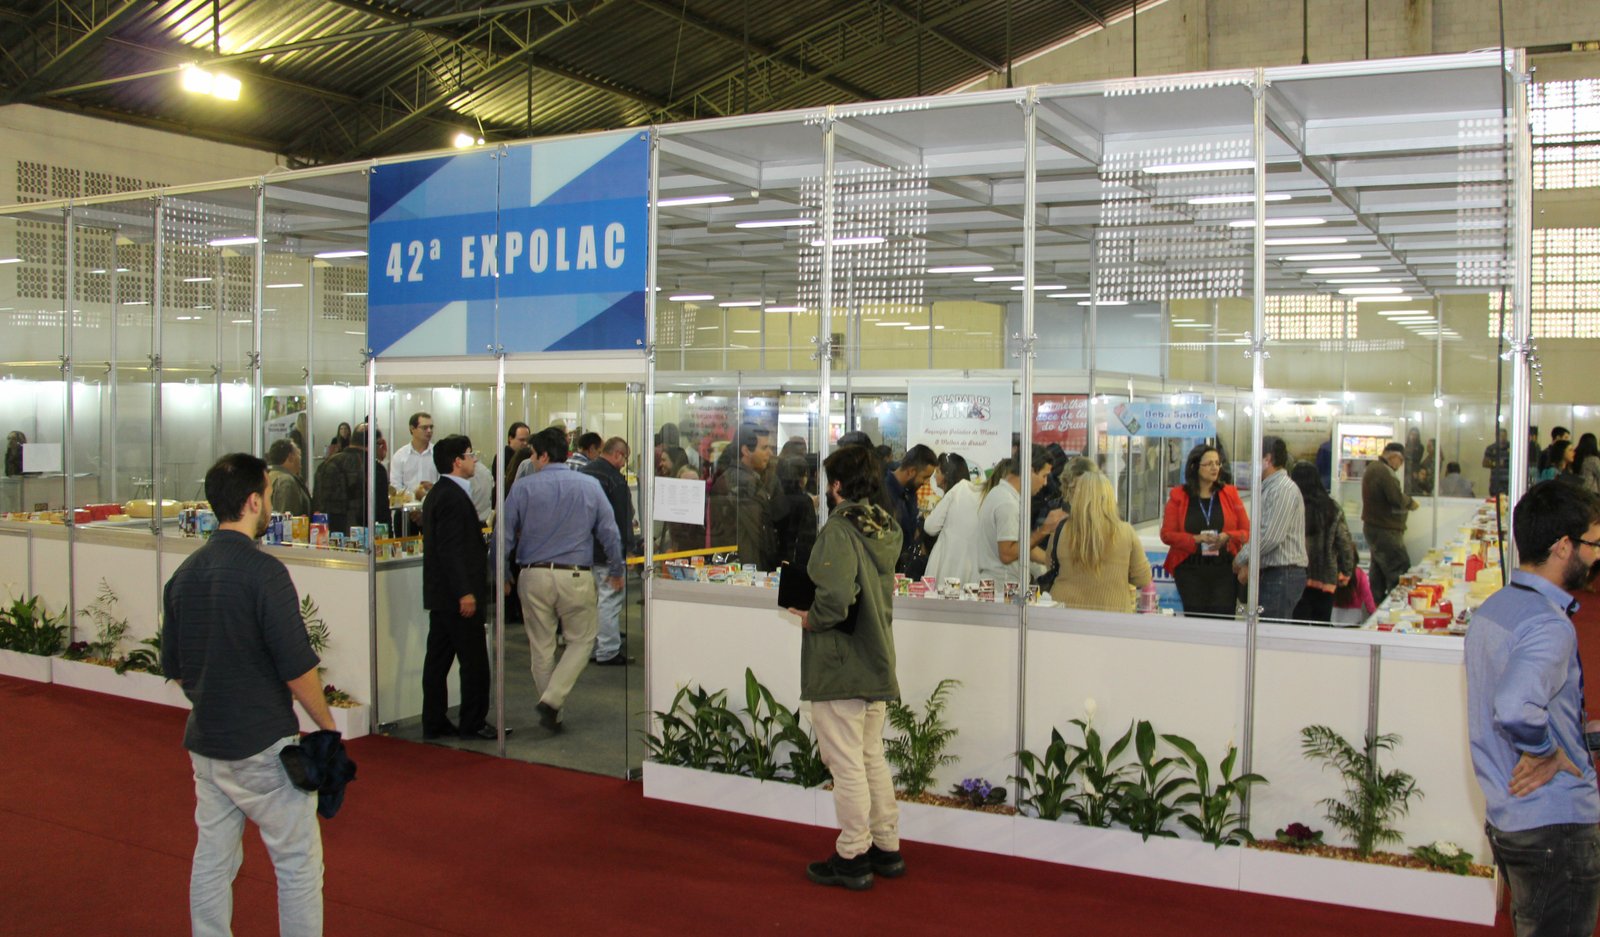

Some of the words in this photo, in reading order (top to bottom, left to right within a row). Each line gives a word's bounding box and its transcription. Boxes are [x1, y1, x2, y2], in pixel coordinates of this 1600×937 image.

[386, 238, 441, 283] 42ª
[461, 222, 626, 279] EXPOLAC
[931, 402, 991, 421] MINAS
[1041, 421, 1055, 431] do
[1174, 421, 1204, 430] Cemil
